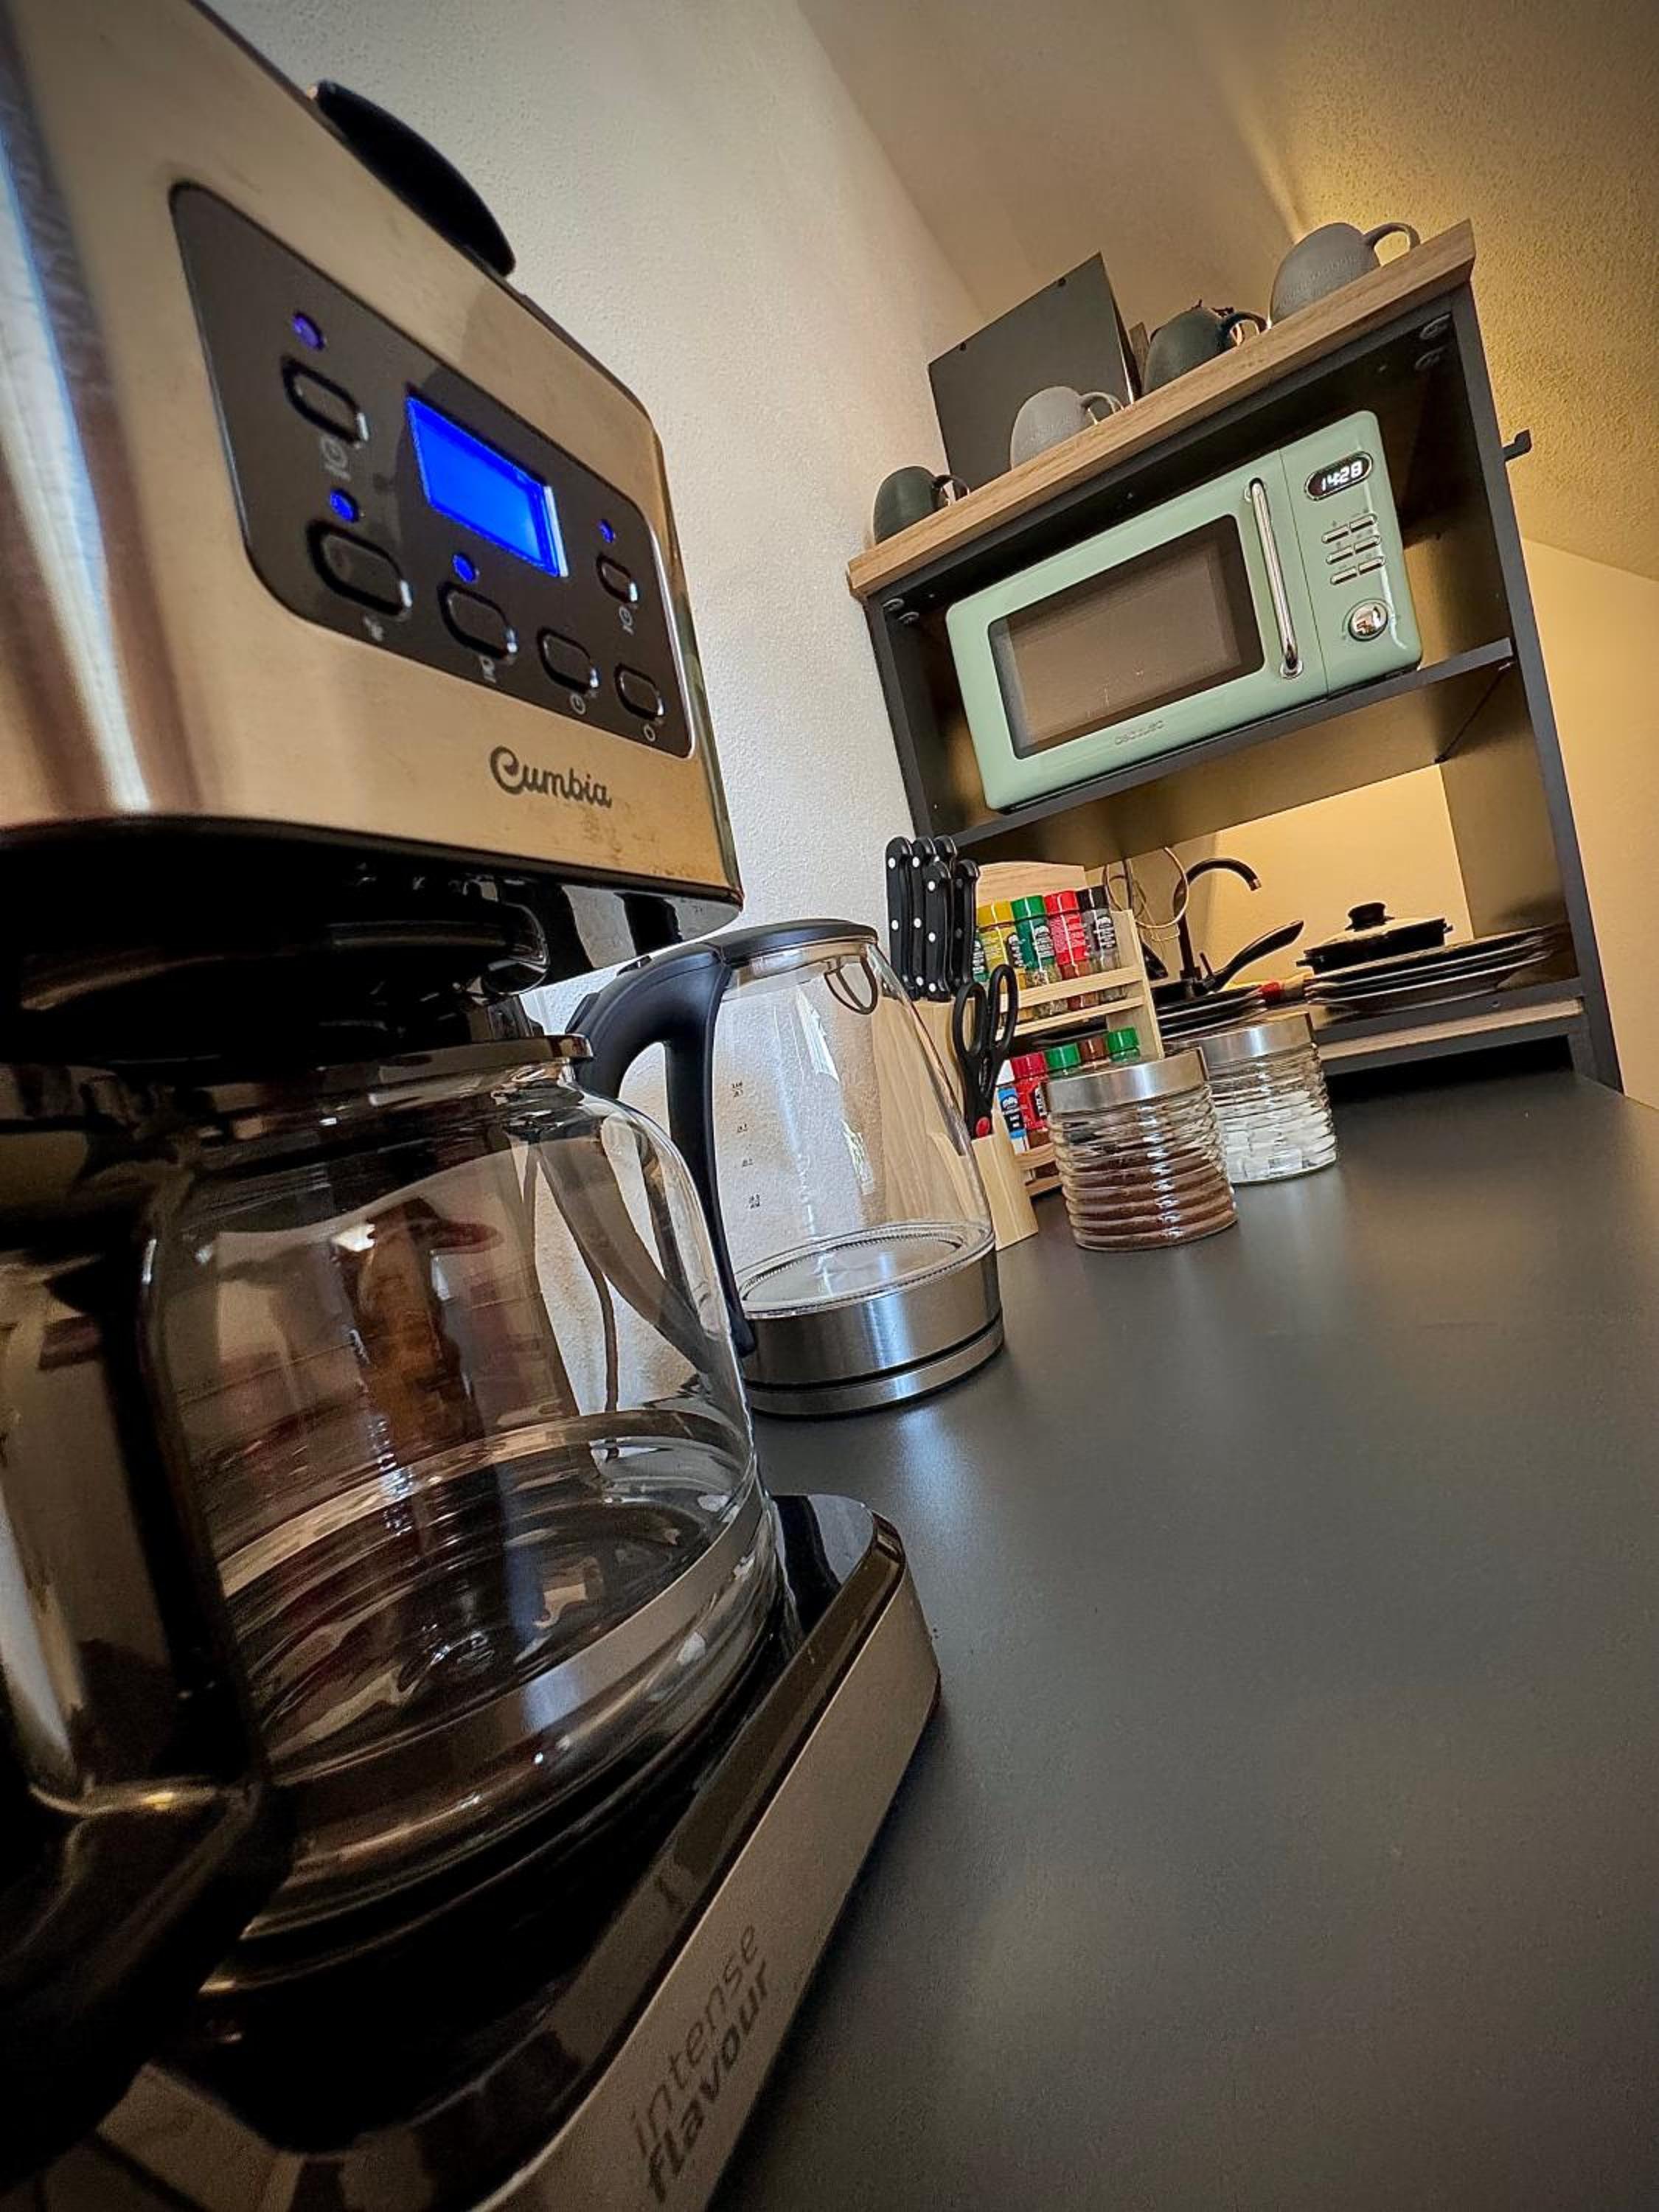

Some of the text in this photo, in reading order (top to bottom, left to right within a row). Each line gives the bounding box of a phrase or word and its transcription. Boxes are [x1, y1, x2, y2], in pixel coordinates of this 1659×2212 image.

[490, 745, 613, 809] Cumbia
[631, 1924, 758, 2157] intense
[649, 1959, 768, 2203] flavour
